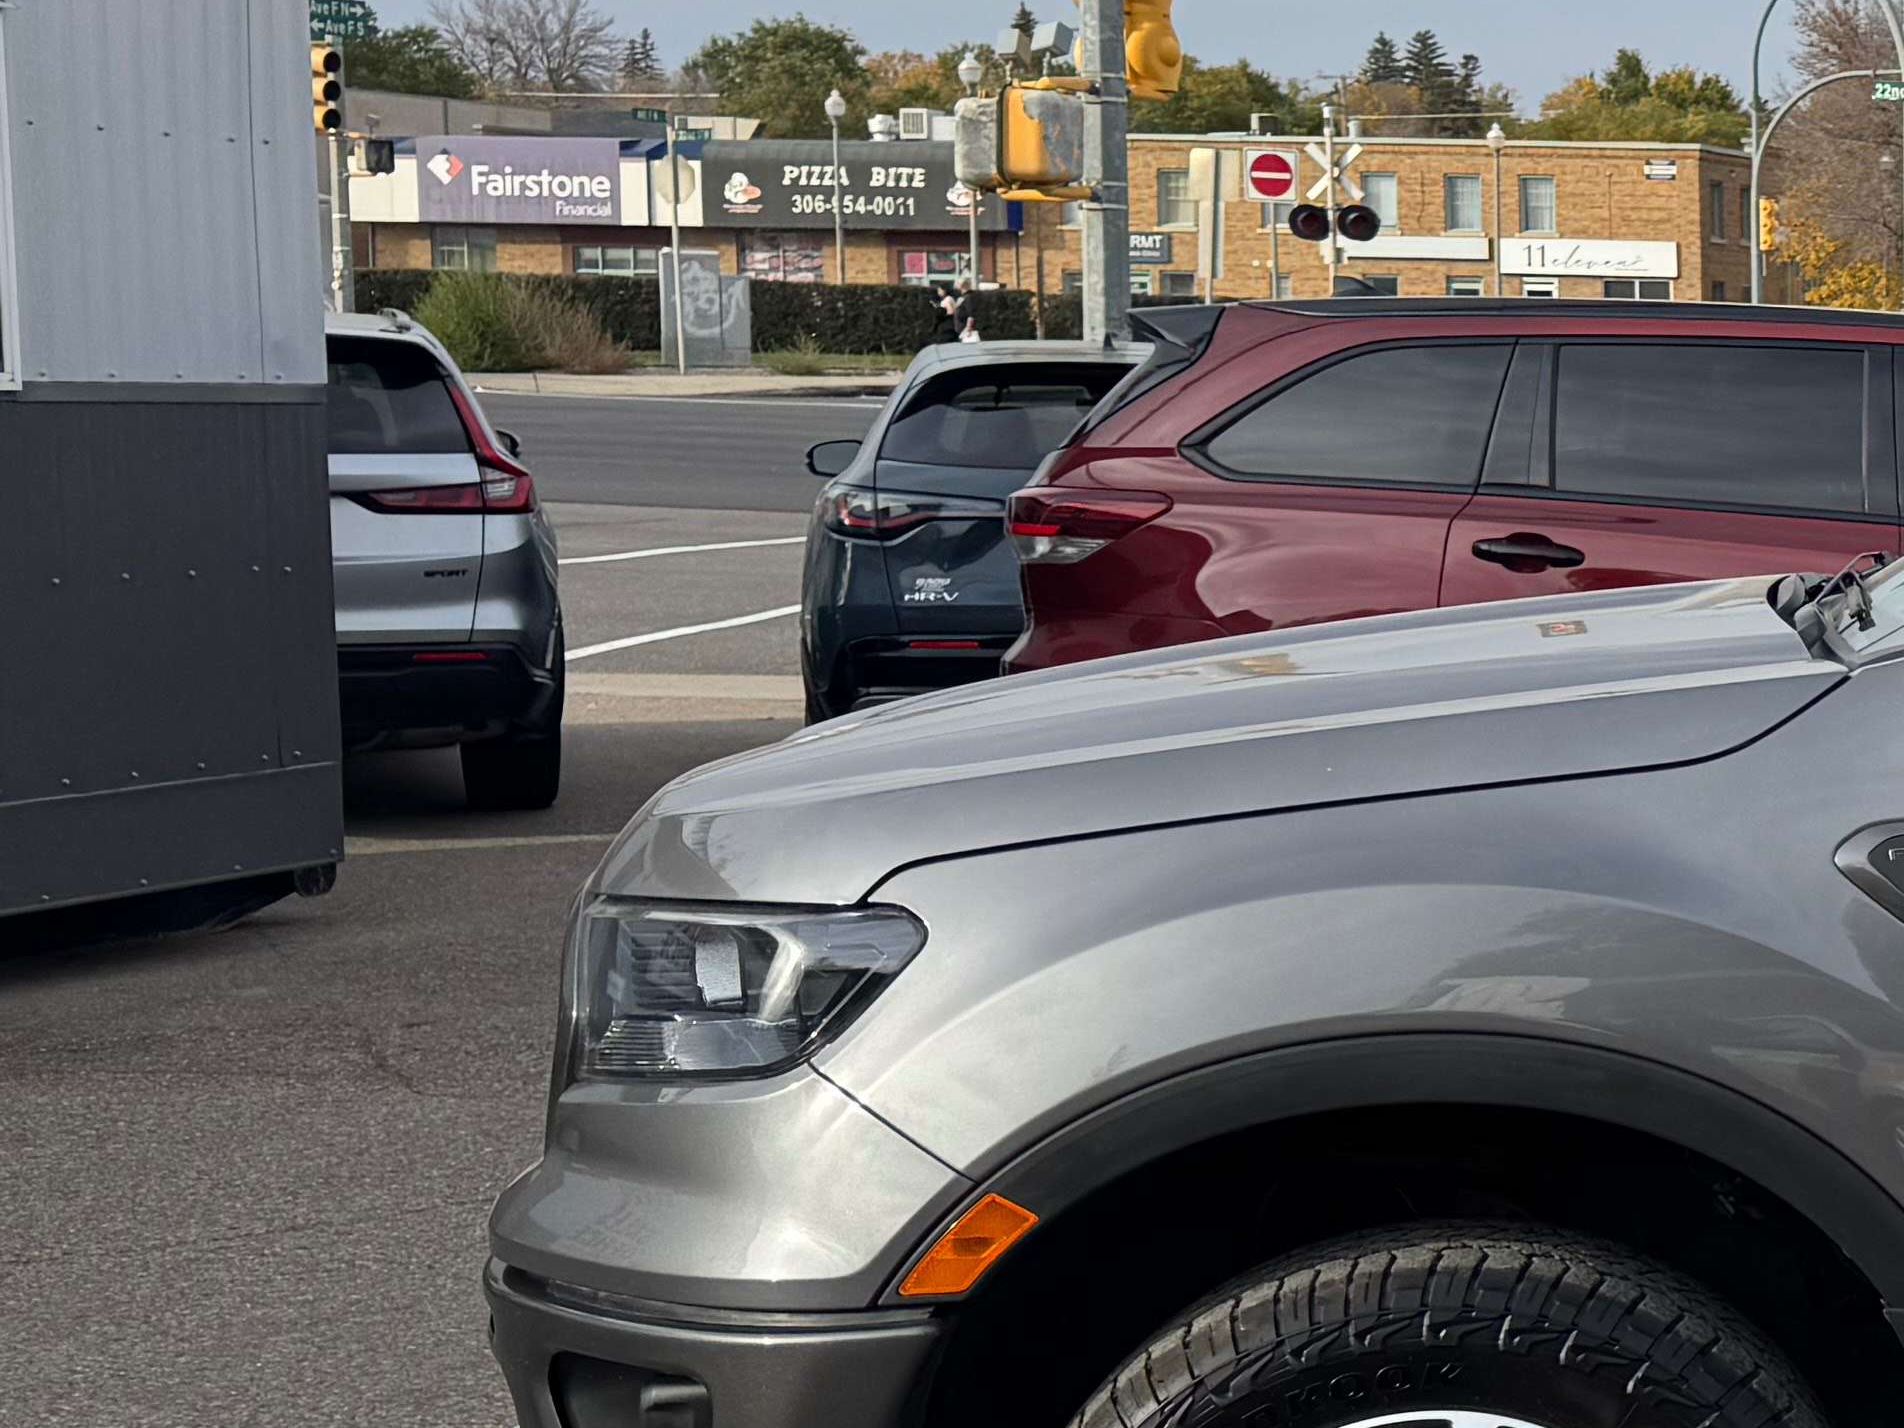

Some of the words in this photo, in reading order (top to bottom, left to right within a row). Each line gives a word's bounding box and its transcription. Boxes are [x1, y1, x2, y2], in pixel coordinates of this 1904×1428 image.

[471, 164, 611, 197] Fairstone
[782, 165, 850, 187] PIZZA
[870, 167, 926, 188] BITE
[556, 200, 612, 216] Financial
[1523, 244, 1546, 268] 11
[904, 591, 959, 602] HR-V
